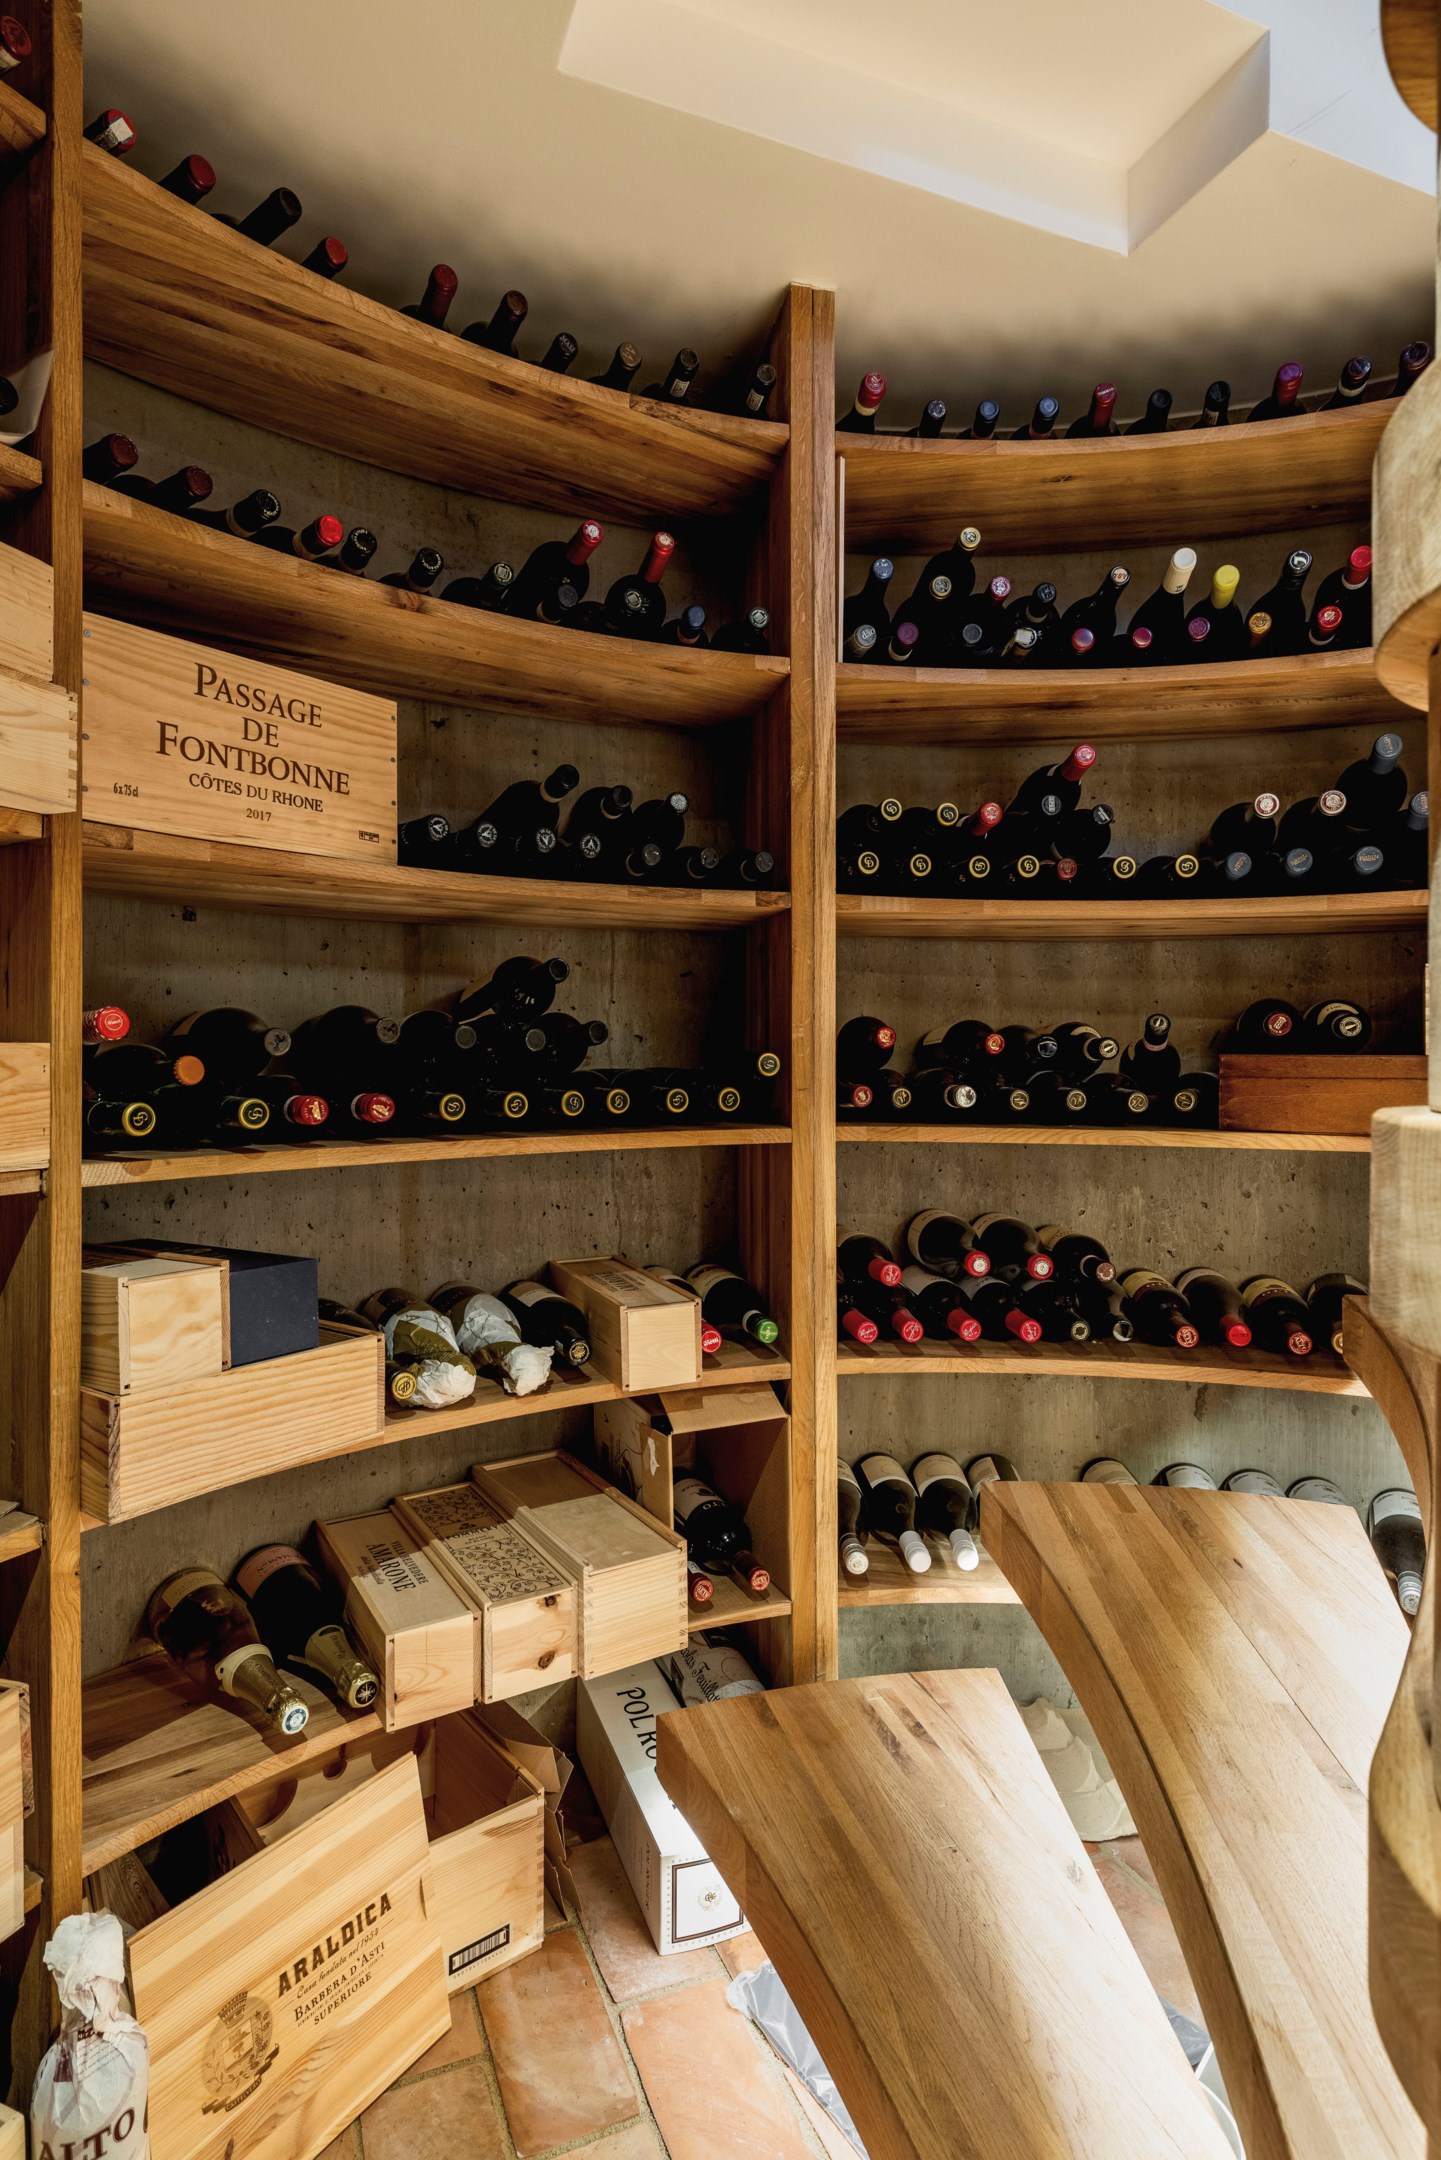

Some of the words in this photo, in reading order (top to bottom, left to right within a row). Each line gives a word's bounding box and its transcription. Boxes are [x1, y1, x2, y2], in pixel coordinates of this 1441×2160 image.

[861, 627, 876, 640] dão
[193, 662, 323, 728] PASSAGE
[241, 716, 280, 748] DE
[155, 720, 351, 796] FONTBONNE
[188, 772, 242, 796] CÔTES
[246, 784, 269, 801] DU
[271, 790, 324, 813] RHONE
[245, 808, 272, 822] 2017
[443, 1525, 499, 1541] POMMERY
[365, 1543, 417, 1592] AMARONE
[616, 1686, 655, 1729] POL
[278, 1892, 392, 1998] ARALDICA
[293, 1974, 348, 2023] BARBERA
[296, 1983, 318, 1999] Casa
[313, 1971, 373, 2027] SUPERIORE
[39, 2107, 135, 2160] ALTO
